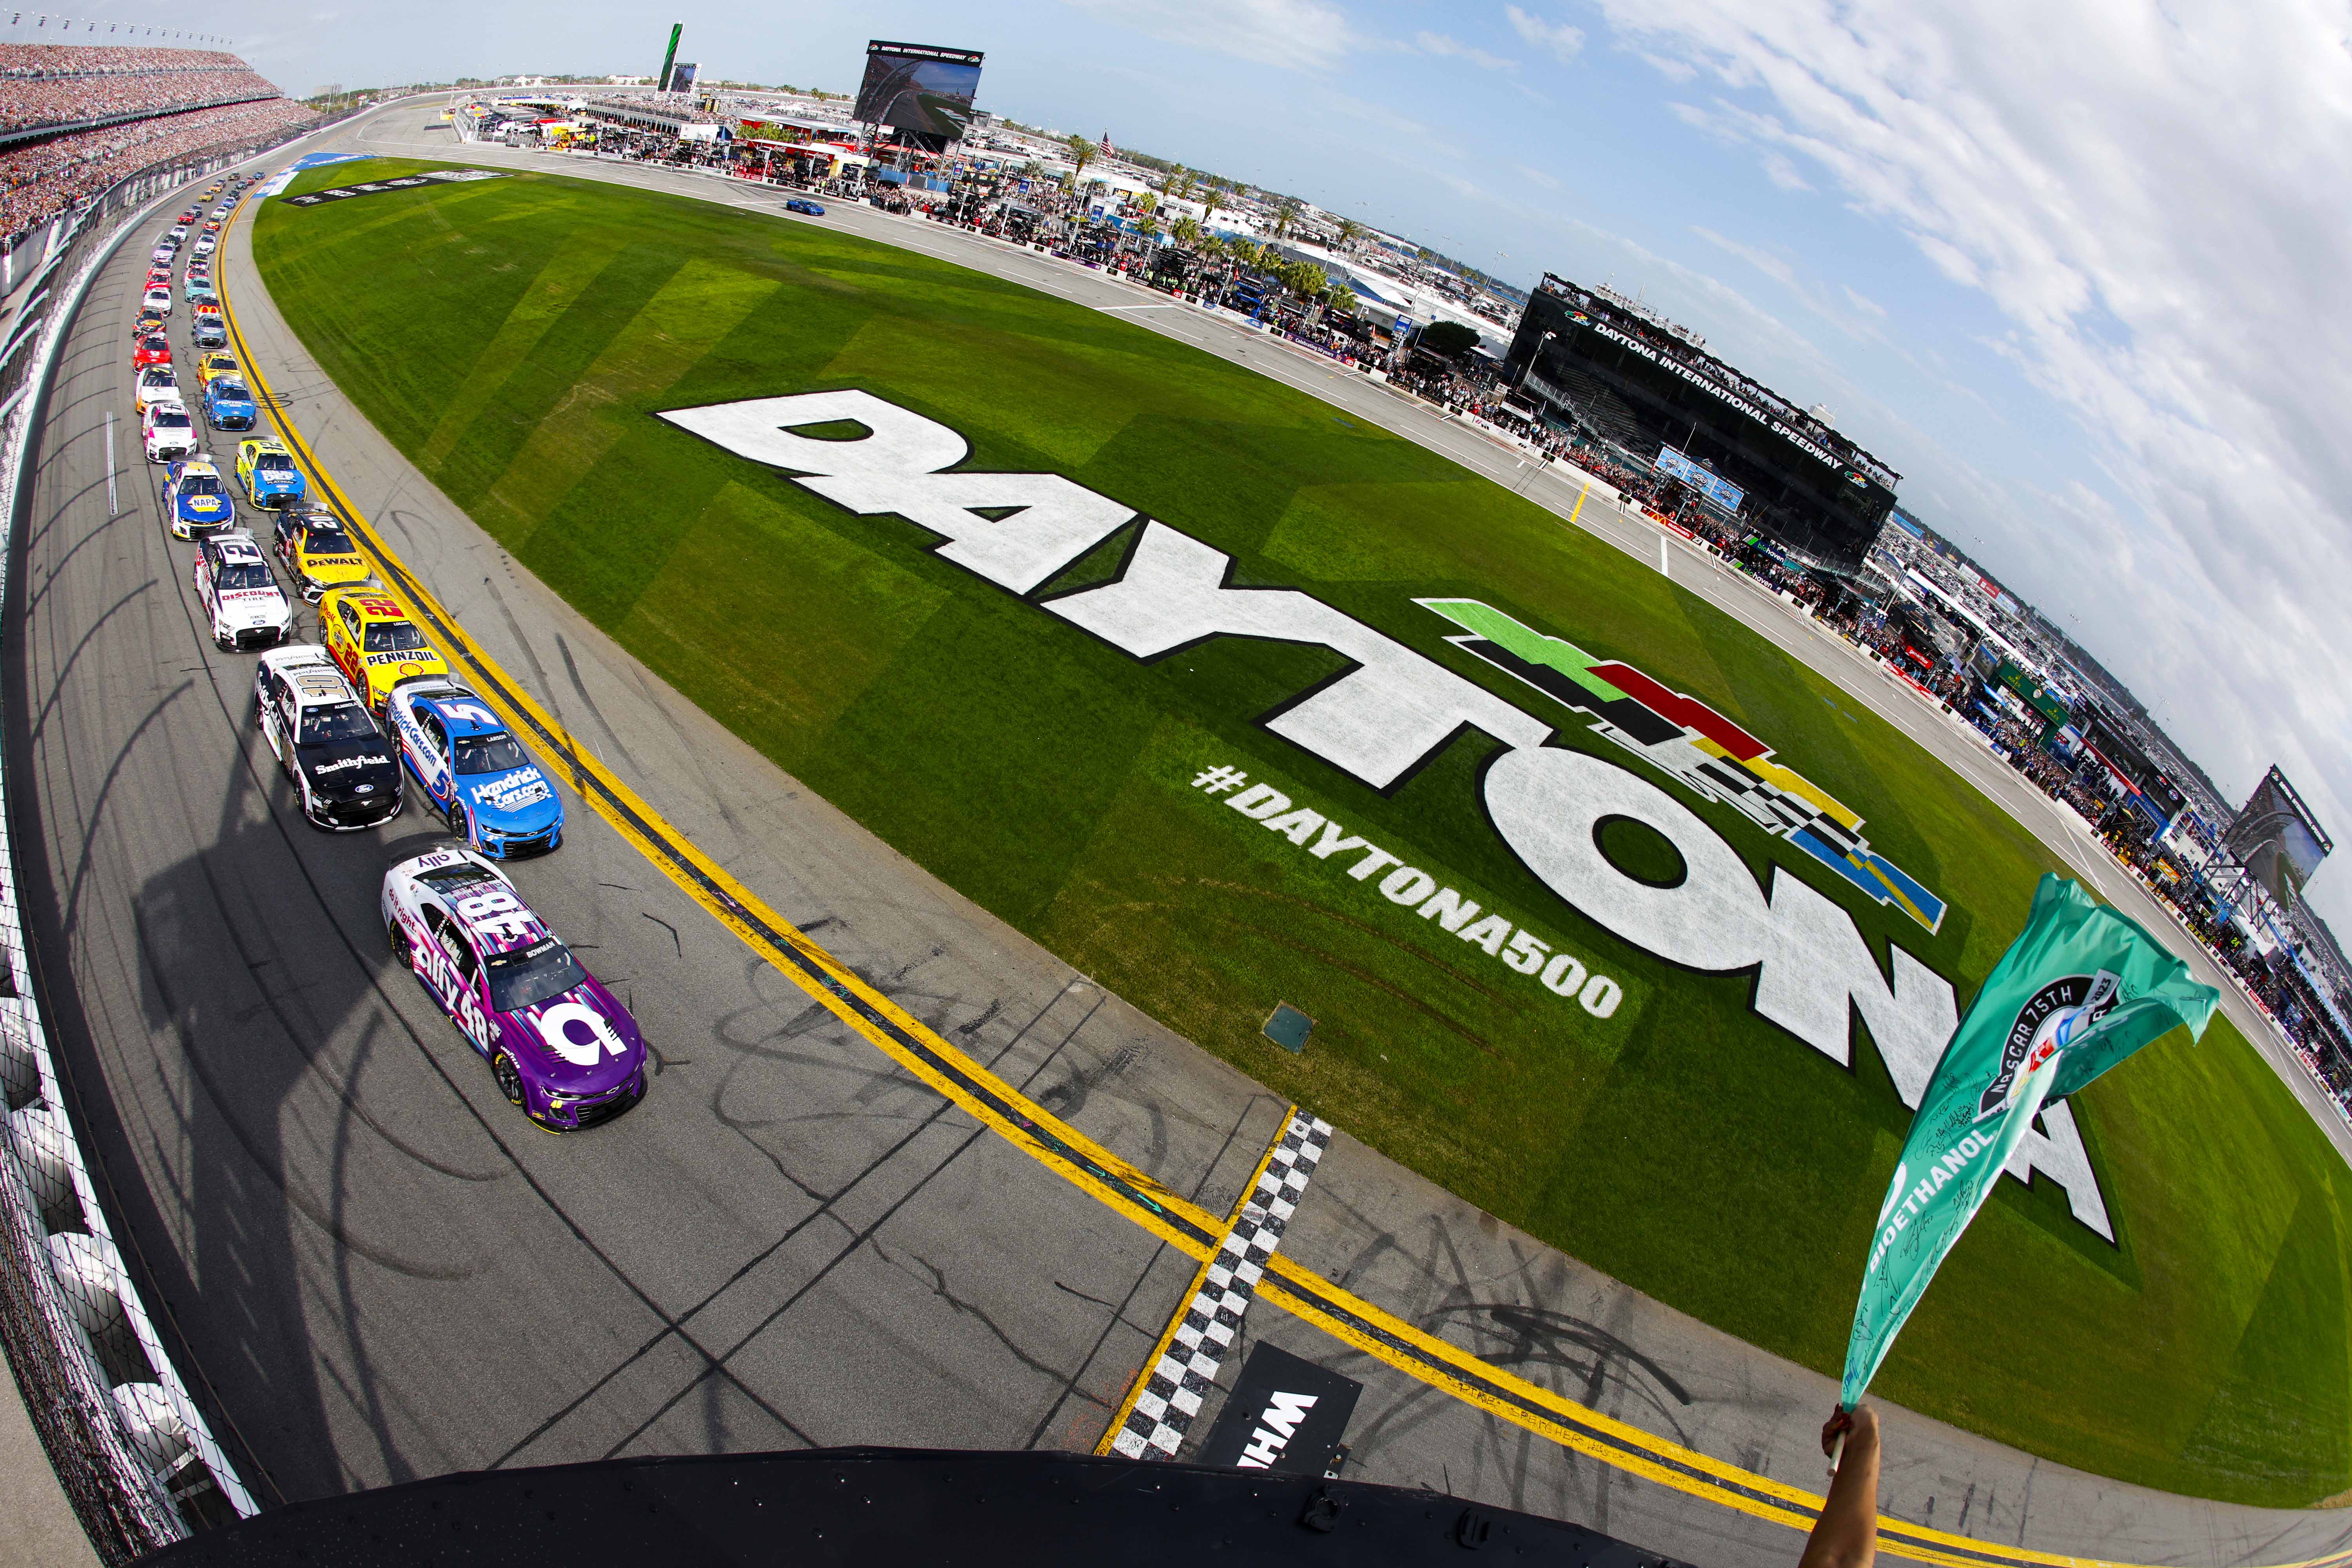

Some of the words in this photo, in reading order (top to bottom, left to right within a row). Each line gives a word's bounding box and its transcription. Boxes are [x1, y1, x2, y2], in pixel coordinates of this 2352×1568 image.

[902, 48, 939, 57] INTERNATIONAL
[940, 52, 967, 60] SPEEDWAY
[1295, 338, 1318, 351] Celebrating
[1322, 348, 1334, 358] years
[1394, 381, 1410, 392] 3CHI
[1594, 323, 1657, 361] DAYTONA
[1658, 357, 1768, 425] INTERNATIONAL
[1770, 421, 1843, 470] SPEEDWAY
[259, 441, 285, 451] 12
[1667, 444, 1678, 452] VICTORY
[1568, 458, 1583, 468] NASCAR
[1693, 474, 1706, 484] 500
[1726, 479, 1737, 488] VICTORY
[193, 498, 217, 507] NAPA
[308, 516, 339, 529] 20
[1667, 522, 1690, 538] McDonald's
[1692, 536, 1702, 544] 23
[223, 544, 260, 557] 2
[1757, 542, 1785, 563] biohaven
[1742, 564, 1773, 589] biohaven
[222, 590, 281, 601] DISCOUNT
[1985, 586, 1996, 596] TOYOTA
[323, 602, 336, 622] Shell
[358, 599, 405, 618] 22
[344, 642, 359, 675] 22
[366, 651, 439, 666] PENNZOIL
[1909, 649, 1929, 665] generator
[296, 675, 352, 699] 10
[1902, 674, 1921, 688] generator
[2007, 675, 2022, 688] ROLEX
[436, 703, 500, 727] 5
[2046, 708, 2060, 720] ROLEX
[486, 734, 507, 742] LARSON
[315, 755, 391, 775] Smithfield
[355, 784, 374, 793] Ford
[432, 768, 451, 797] 5
[470, 766, 542, 804] Hendrick
[493, 780, 550, 809] Cars.com
[2144, 802, 2163, 822] CHEVROLET
[418, 854, 450, 867] ally
[388, 888, 395, 900] do
[394, 897, 399, 910] it
[1191, 765, 1623, 1019] #DAYTONA500
[456, 890, 535, 936] 48
[526, 940, 556, 958] BOWMAN
[2230, 937, 2241, 948] 24
[413, 944, 459, 1011] ally
[2091, 977, 2111, 1001] 2023
[461, 994, 490, 1053] 48
[1990, 1023, 2033, 1093] NASCAR
[2025, 985, 2072, 1022] 75TH
[550, 1100, 563, 1109] 48
[1870, 1129, 1994, 1274] BIOETHANOL
